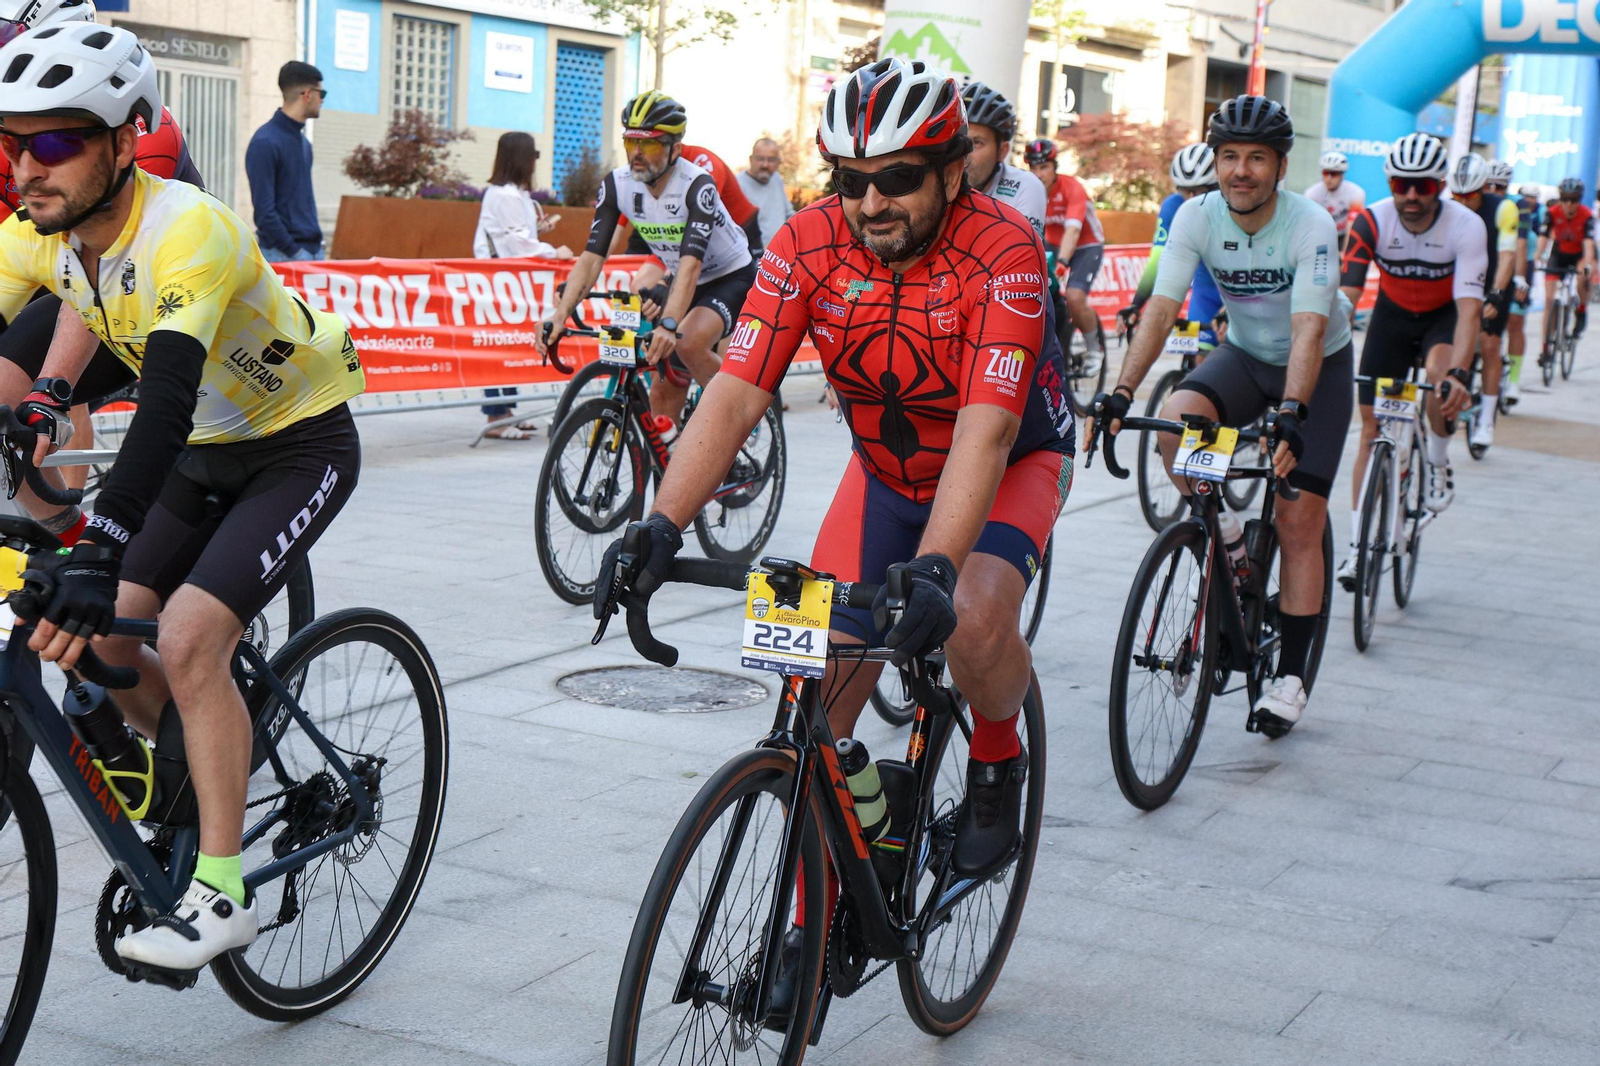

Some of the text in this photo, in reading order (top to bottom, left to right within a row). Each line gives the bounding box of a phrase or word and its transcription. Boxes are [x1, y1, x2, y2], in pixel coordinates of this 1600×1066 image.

[303, 273, 440, 329] FROIZ
[614, 311, 636, 322] 505
[603, 345, 629, 358] 320
[221, 359, 248, 385] SERVICIOS
[229, 346, 284, 393] LUSTAND
[1380, 399, 1411, 413] 497
[260, 463, 339, 580] SCOTT
[753, 623, 814, 653] 224
[67, 730, 122, 825] TRIBAN
